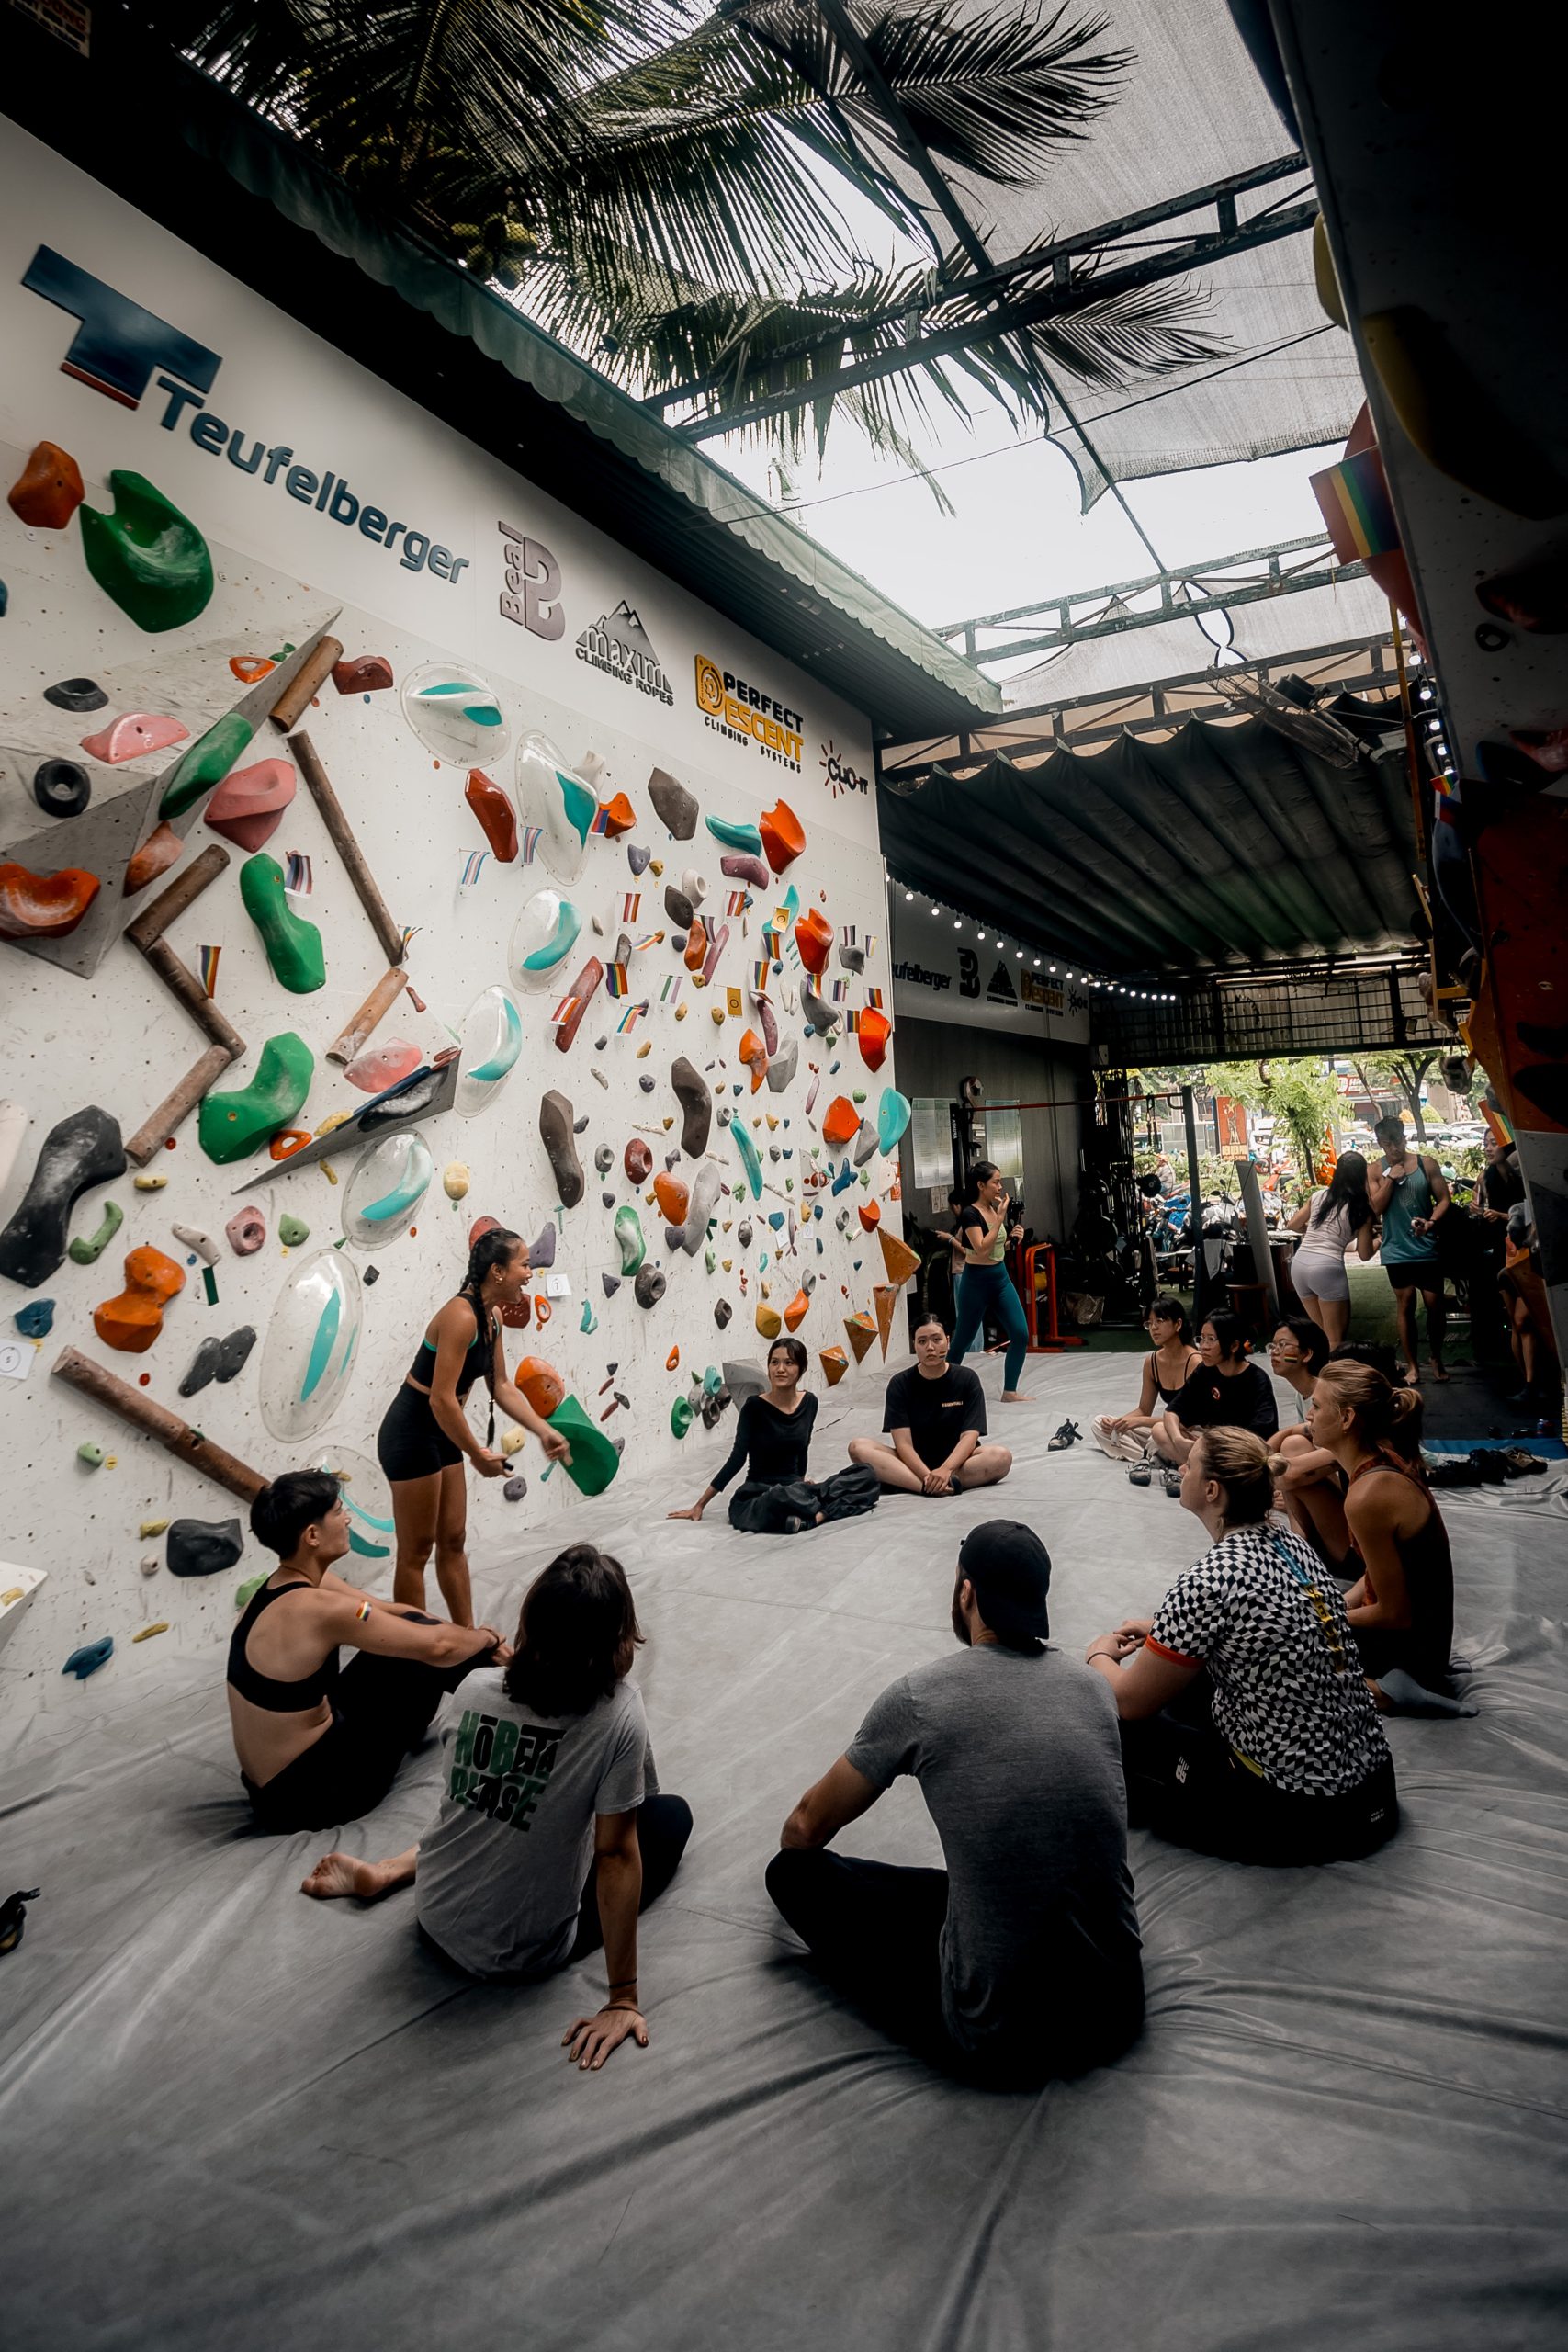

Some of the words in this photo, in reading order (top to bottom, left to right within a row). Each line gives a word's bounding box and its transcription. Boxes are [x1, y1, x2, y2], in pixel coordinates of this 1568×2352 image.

[156, 375, 469, 584] Teufelberger
[497, 520, 523, 626] Beal
[575, 647, 633, 684] CLIMBING
[635, 678, 674, 707] ROPES
[585, 627, 666, 691] maxim
[723, 671, 804, 733] PERFECT
[704, 716, 749, 747] CLIMBING
[760, 745, 802, 774] SYSTEMS
